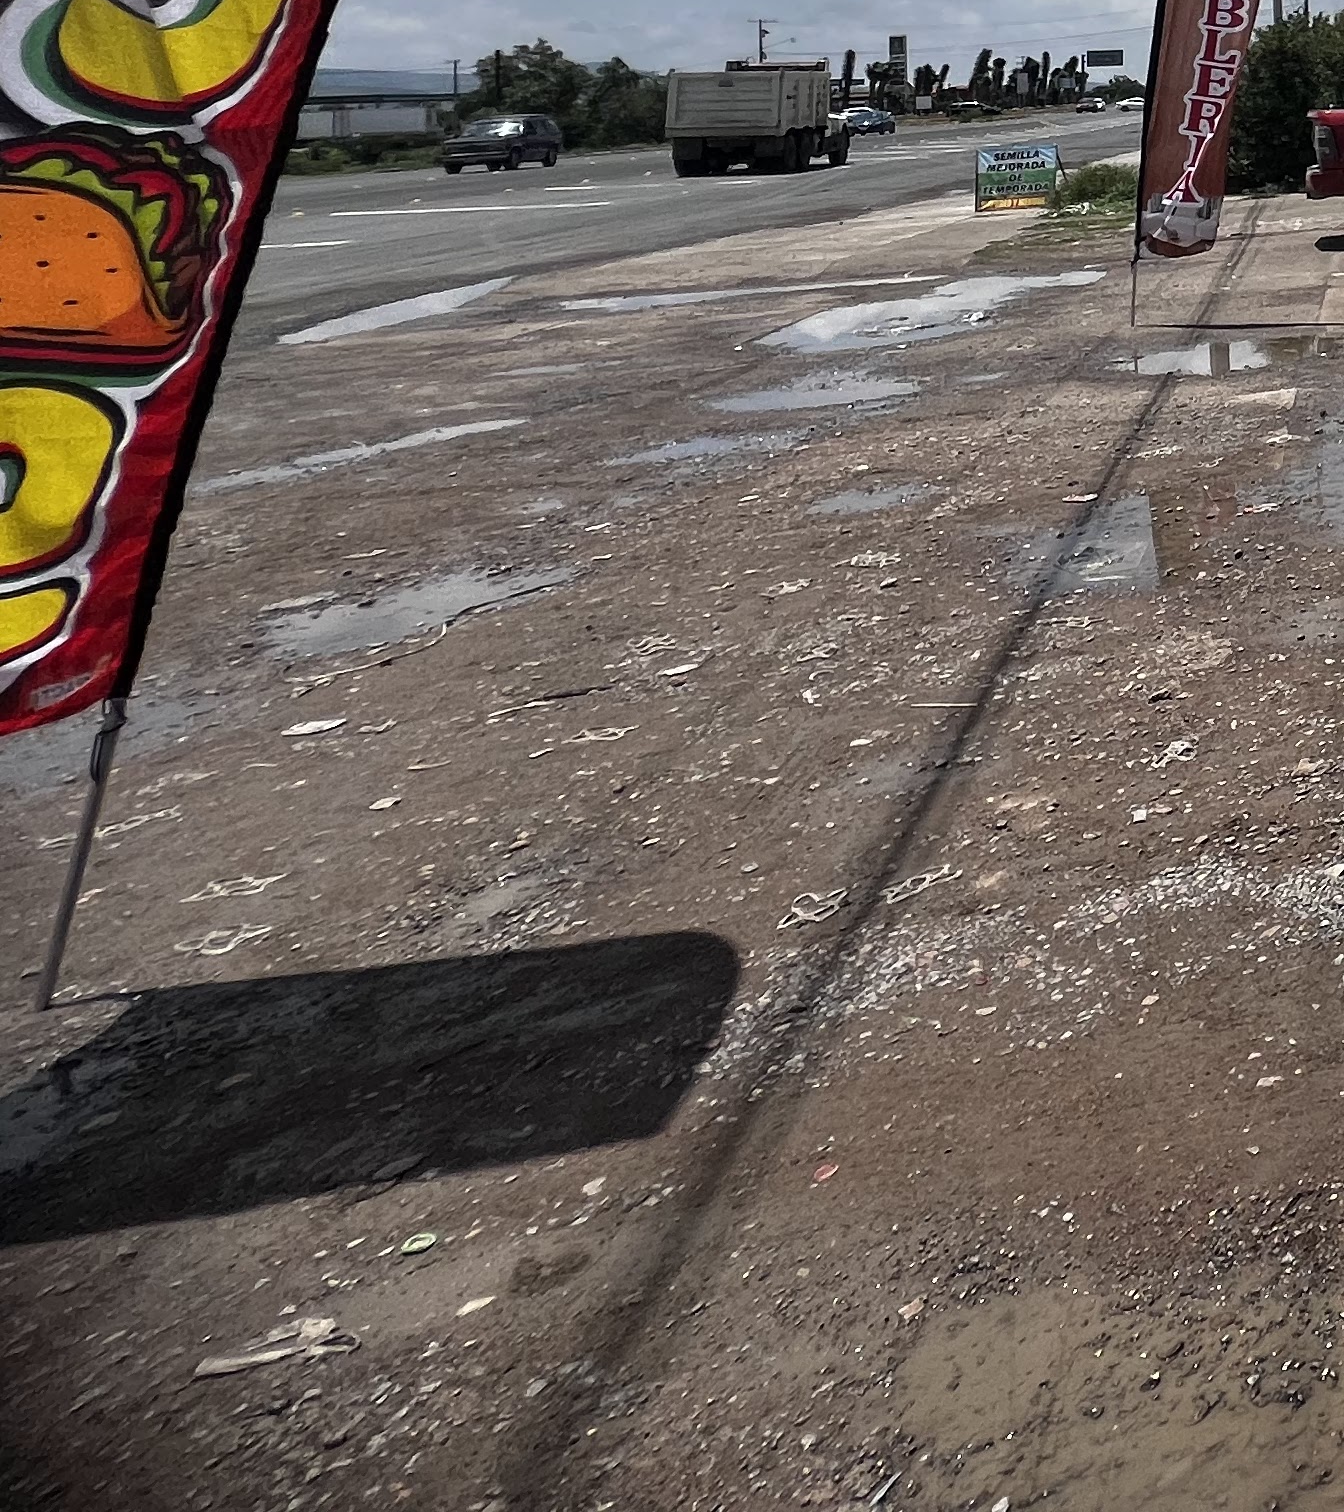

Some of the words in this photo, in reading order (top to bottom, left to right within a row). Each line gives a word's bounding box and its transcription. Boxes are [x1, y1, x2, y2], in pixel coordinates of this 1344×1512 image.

[994, 150, 1040, 161] SEMILLA
[986, 161, 1046, 172] MEJORADA
[1009, 174, 1023, 182] DE
[983, 183, 1050, 195] TEMPORADA
